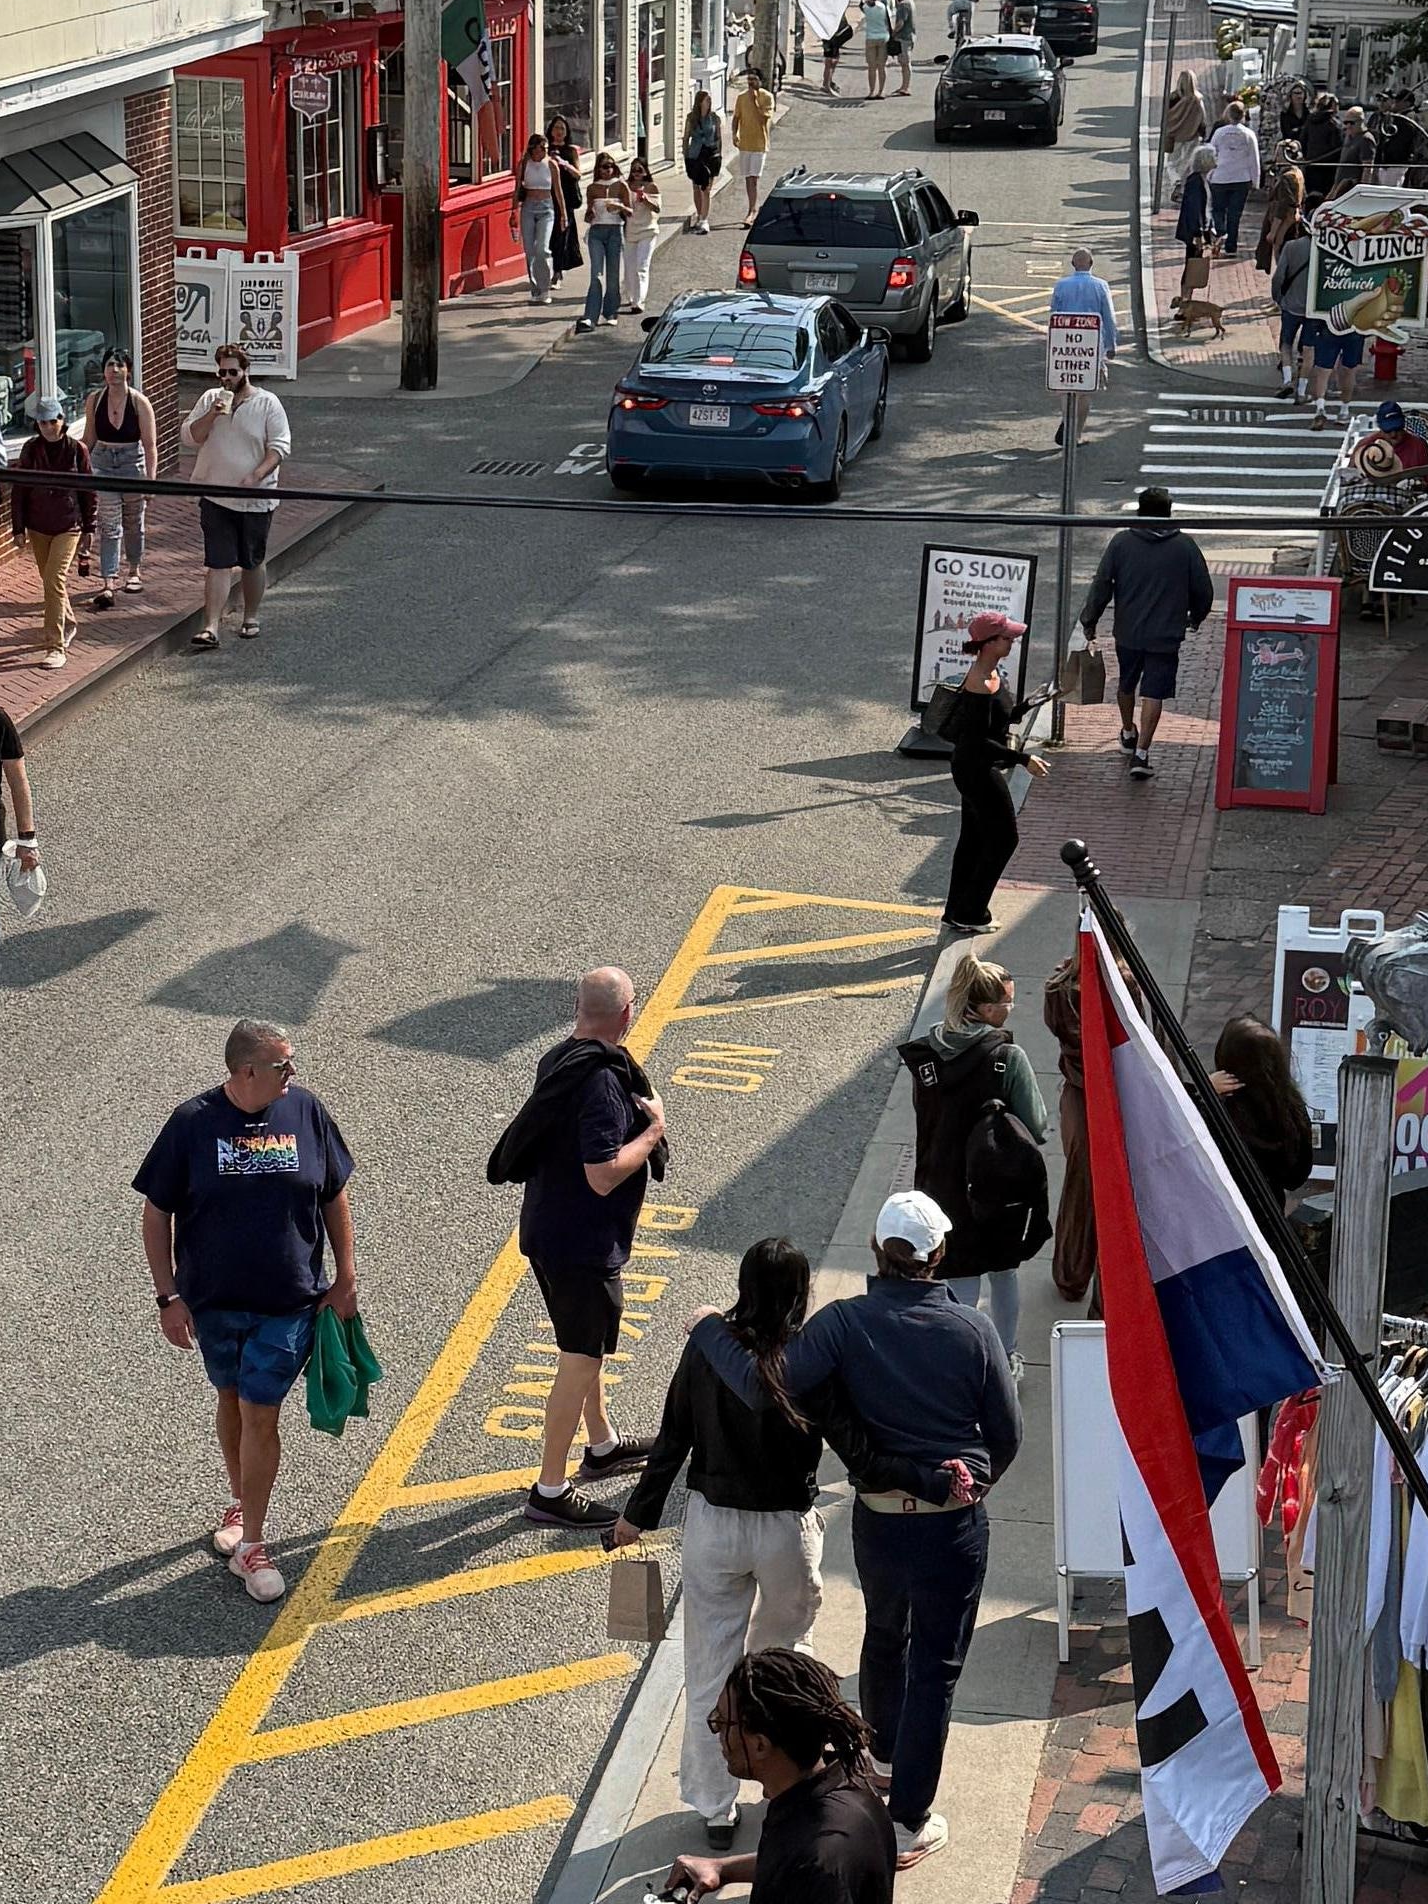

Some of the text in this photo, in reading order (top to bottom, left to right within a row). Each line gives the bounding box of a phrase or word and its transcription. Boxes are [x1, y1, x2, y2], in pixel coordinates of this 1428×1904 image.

[1318, 228, 1426, 262] BOX LUNCH
[1053, 315, 1098, 328] TOW ZONE
[1065, 333, 1083, 344] NO
[1052, 346, 1094, 358] PARKING
[1054, 359, 1091, 371] EITHER
[1059, 373, 1084, 384] SIDE
[934, 557, 1027, 582] GO SLOW
[1294, 996, 1344, 1020] ROY
